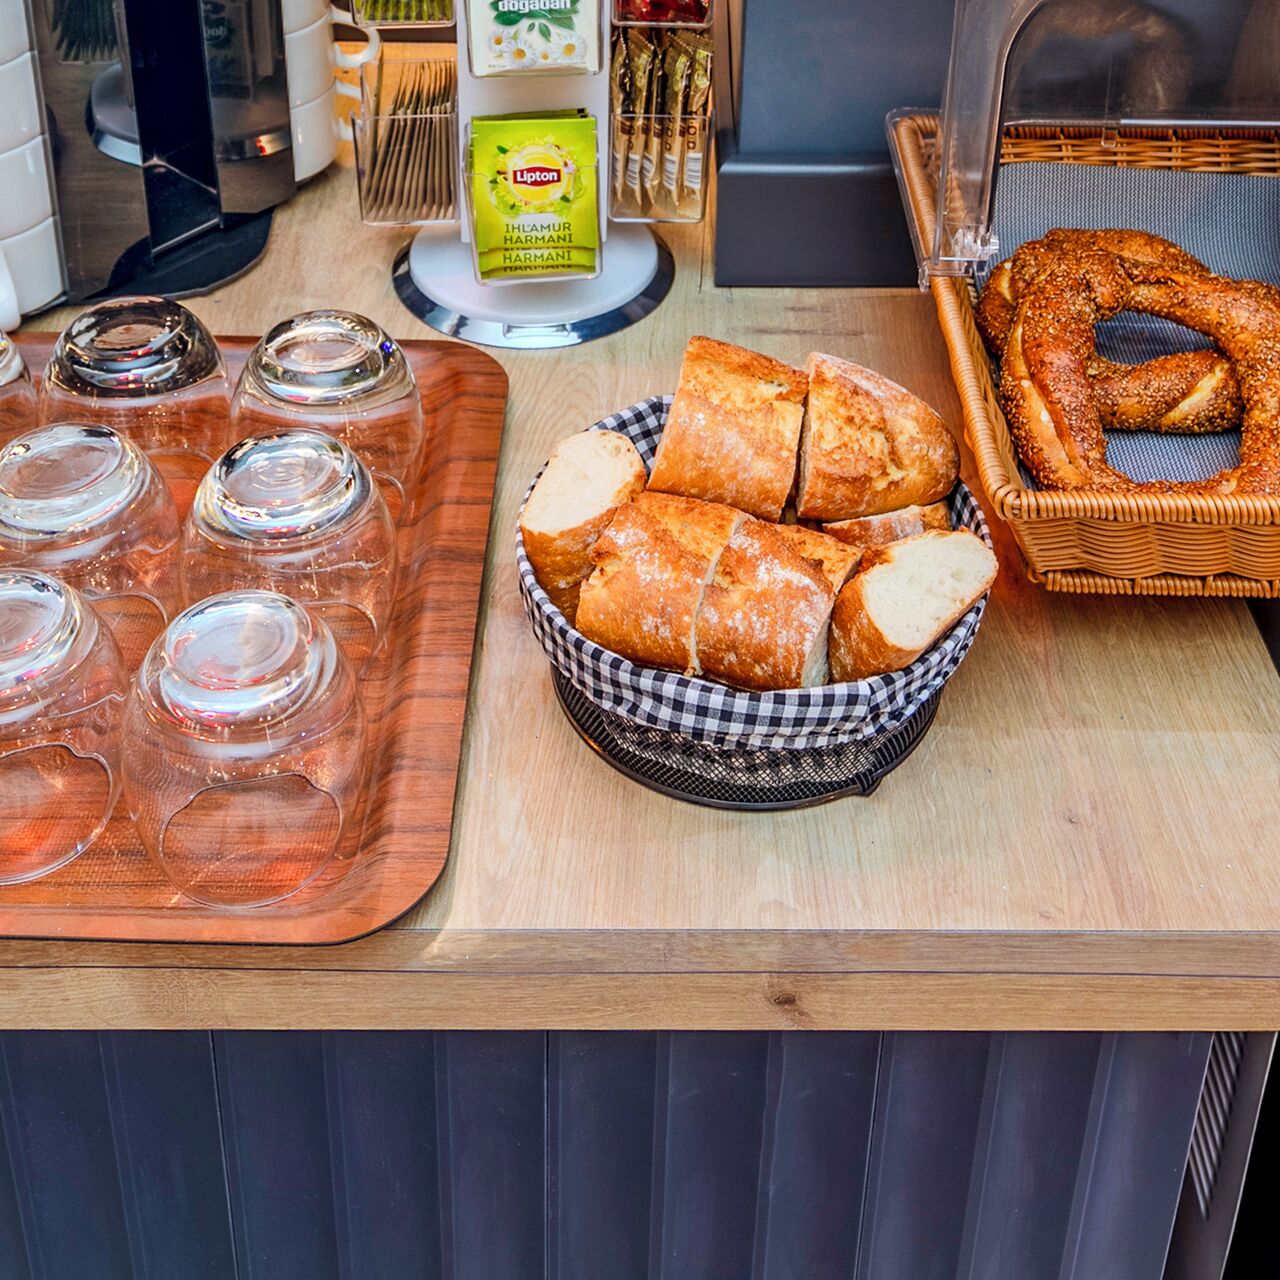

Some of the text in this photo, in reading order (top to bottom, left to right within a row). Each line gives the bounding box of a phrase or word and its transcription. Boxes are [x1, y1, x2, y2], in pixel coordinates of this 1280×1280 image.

[516, 169, 558, 184] Lipton
[505, 222, 571, 233] IHLAMUR
[503, 233, 573, 245] HARMANI
[502, 250, 572, 264] HARMANI
